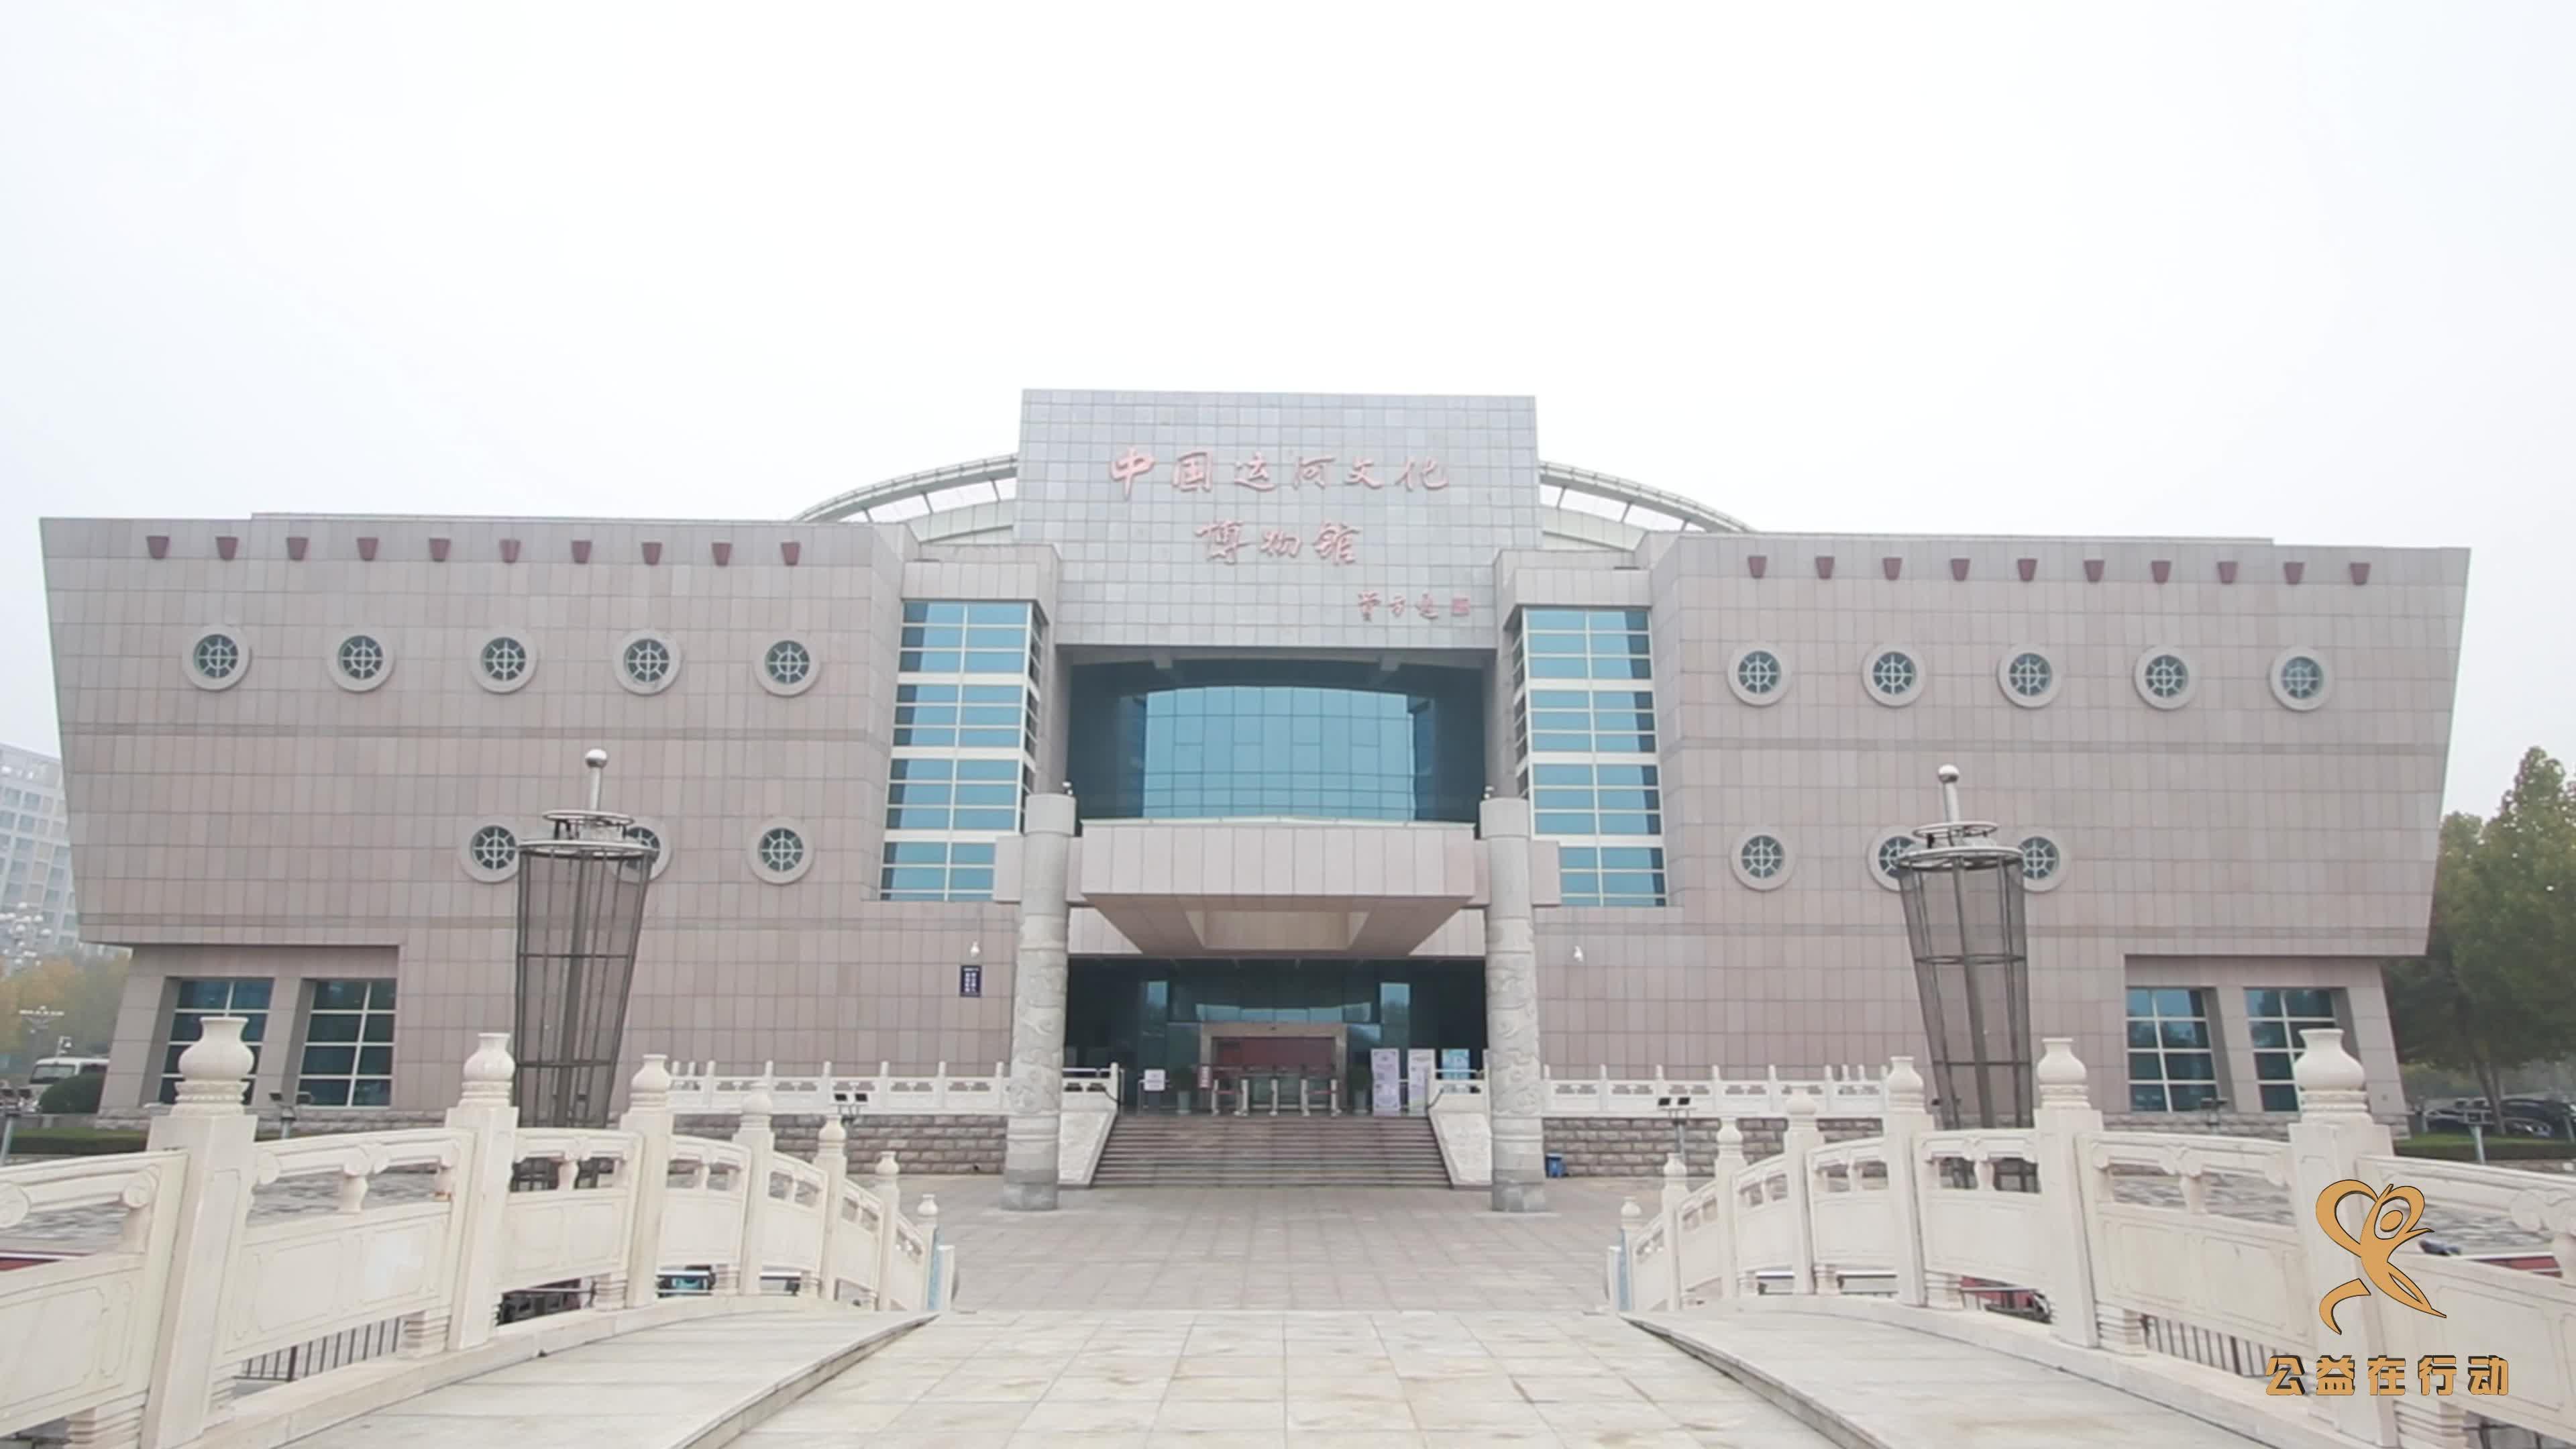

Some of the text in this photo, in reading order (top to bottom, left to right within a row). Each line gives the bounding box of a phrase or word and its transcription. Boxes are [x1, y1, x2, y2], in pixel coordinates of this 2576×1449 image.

[1110, 446, 1450, 500] 中国运河文化
